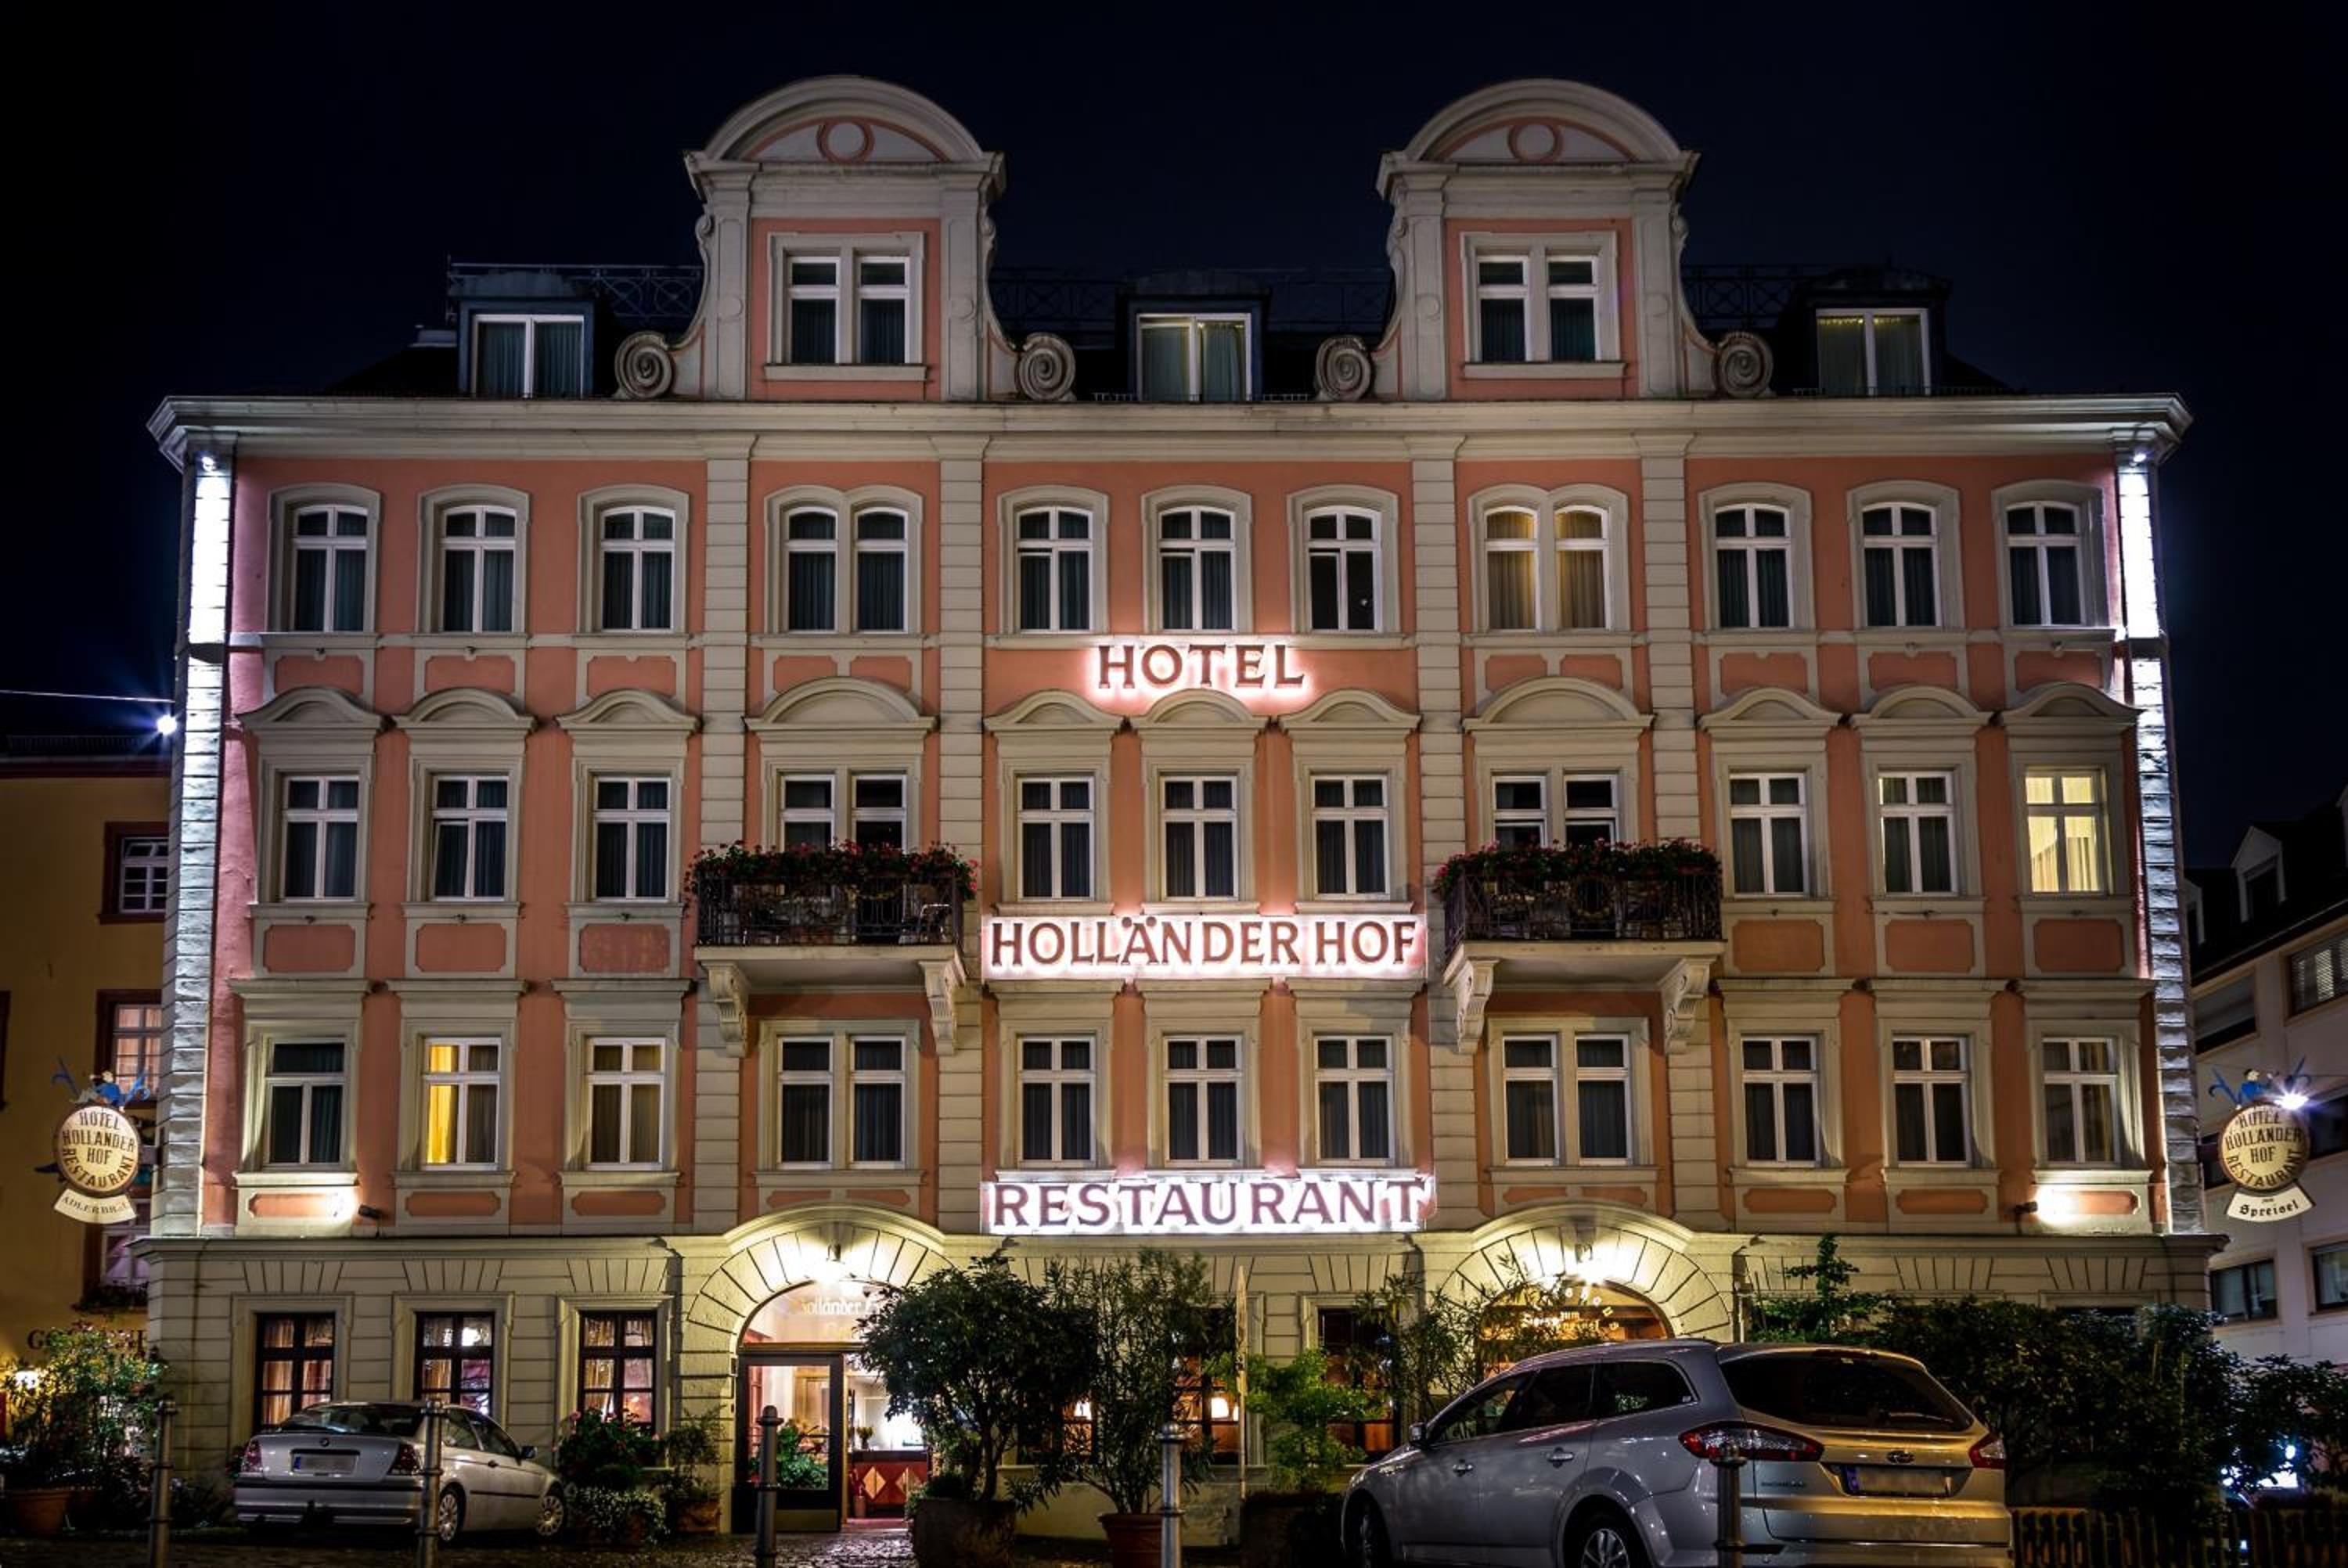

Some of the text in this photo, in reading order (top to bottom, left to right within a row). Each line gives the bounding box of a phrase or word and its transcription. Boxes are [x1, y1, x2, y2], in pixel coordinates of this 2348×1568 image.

[1098, 643, 1305, 689] HOTEL
[991, 915, 1417, 967] HOLLÄNDER HOF
[79, 1111, 121, 1131] HOTEL
[2239, 1110, 2281, 1128] HOTEL
[62, 1148, 135, 1189] RESTAURANT
[87, 1147, 113, 1165] HOF
[2225, 1148, 2303, 1188] RESTAURANT
[2250, 1146, 2277, 1164] HOF
[993, 1176, 1424, 1227] RESTAURANT
[2239, 1199, 2299, 1217] Spreisel
